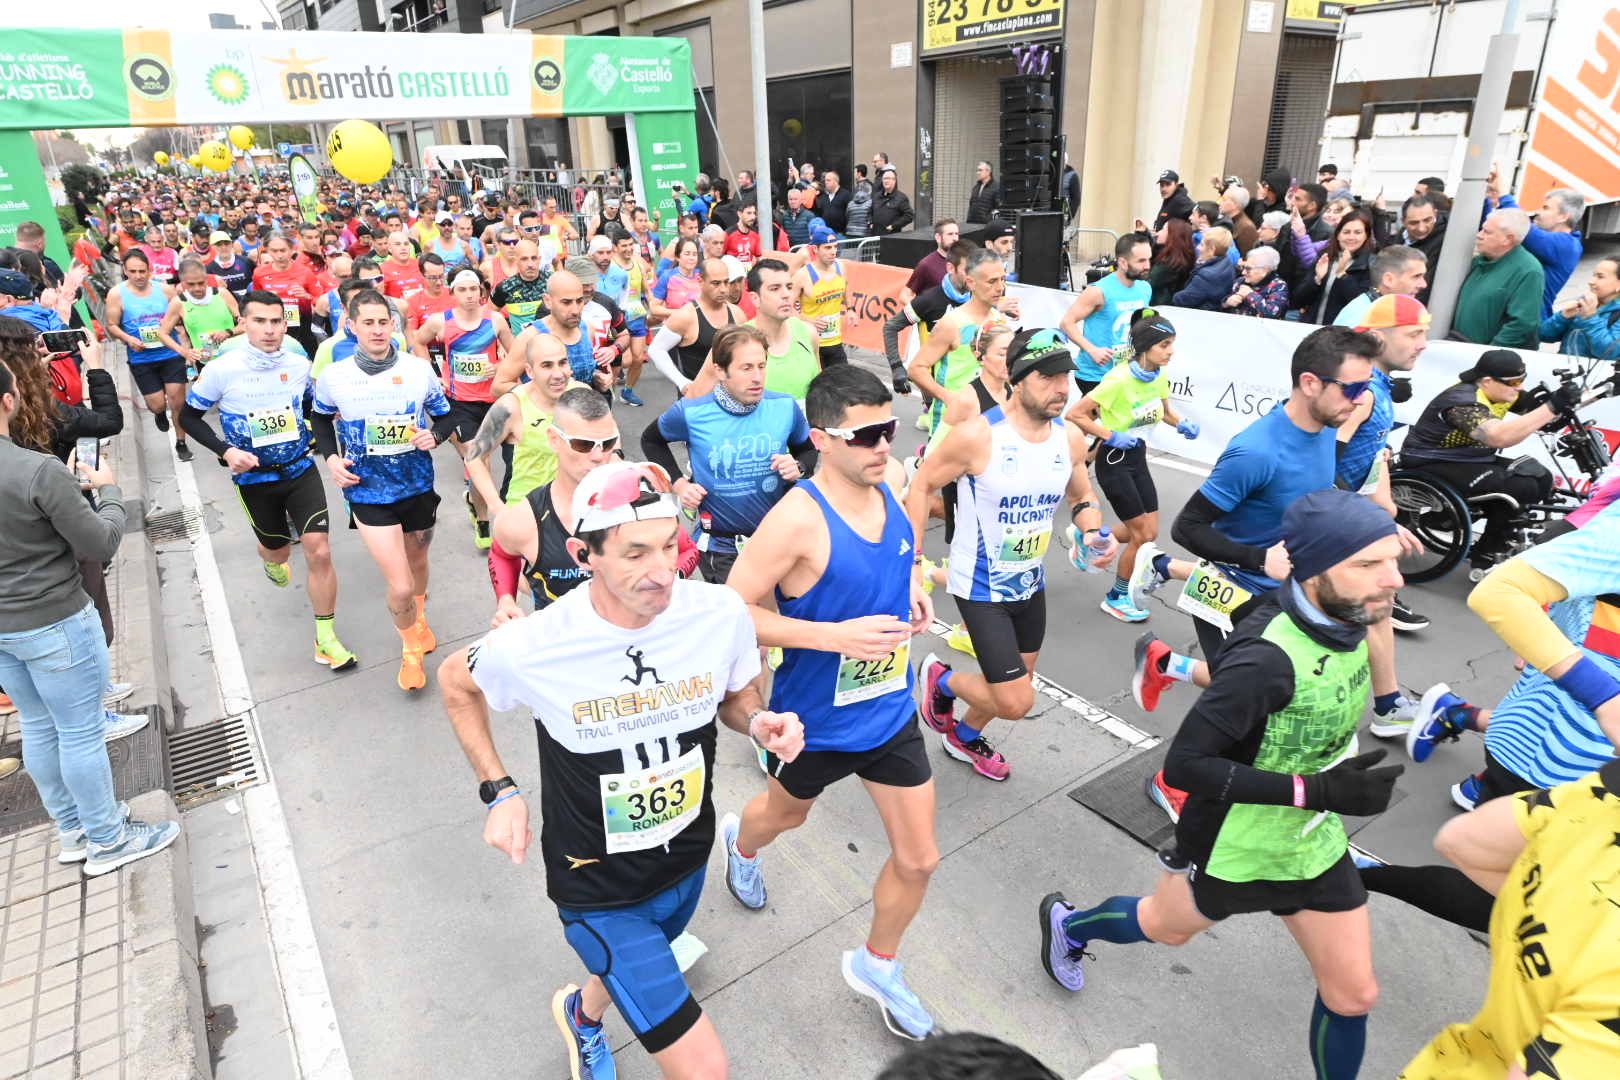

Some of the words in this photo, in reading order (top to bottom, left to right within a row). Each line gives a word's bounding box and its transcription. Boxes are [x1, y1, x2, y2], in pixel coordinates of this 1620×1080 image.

[286, 64, 395, 101] marató
[398, 65, 510, 98] CASTELLÓ
[621, 66, 673, 83] Castelló
[460, 361, 482, 372] 203
[259, 414, 287, 433] 336
[376, 425, 407, 441] 347
[1012, 534, 1041, 555] 411
[1197, 575, 1234, 605] 630
[852, 651, 896, 681] 222
[571, 671, 714, 725] FIREHAWK
[575, 726, 613, 741] TRAIL
[617, 710, 680, 734] RUNNING
[627, 778, 686, 821] 363
[631, 805, 684, 832] RONALD
